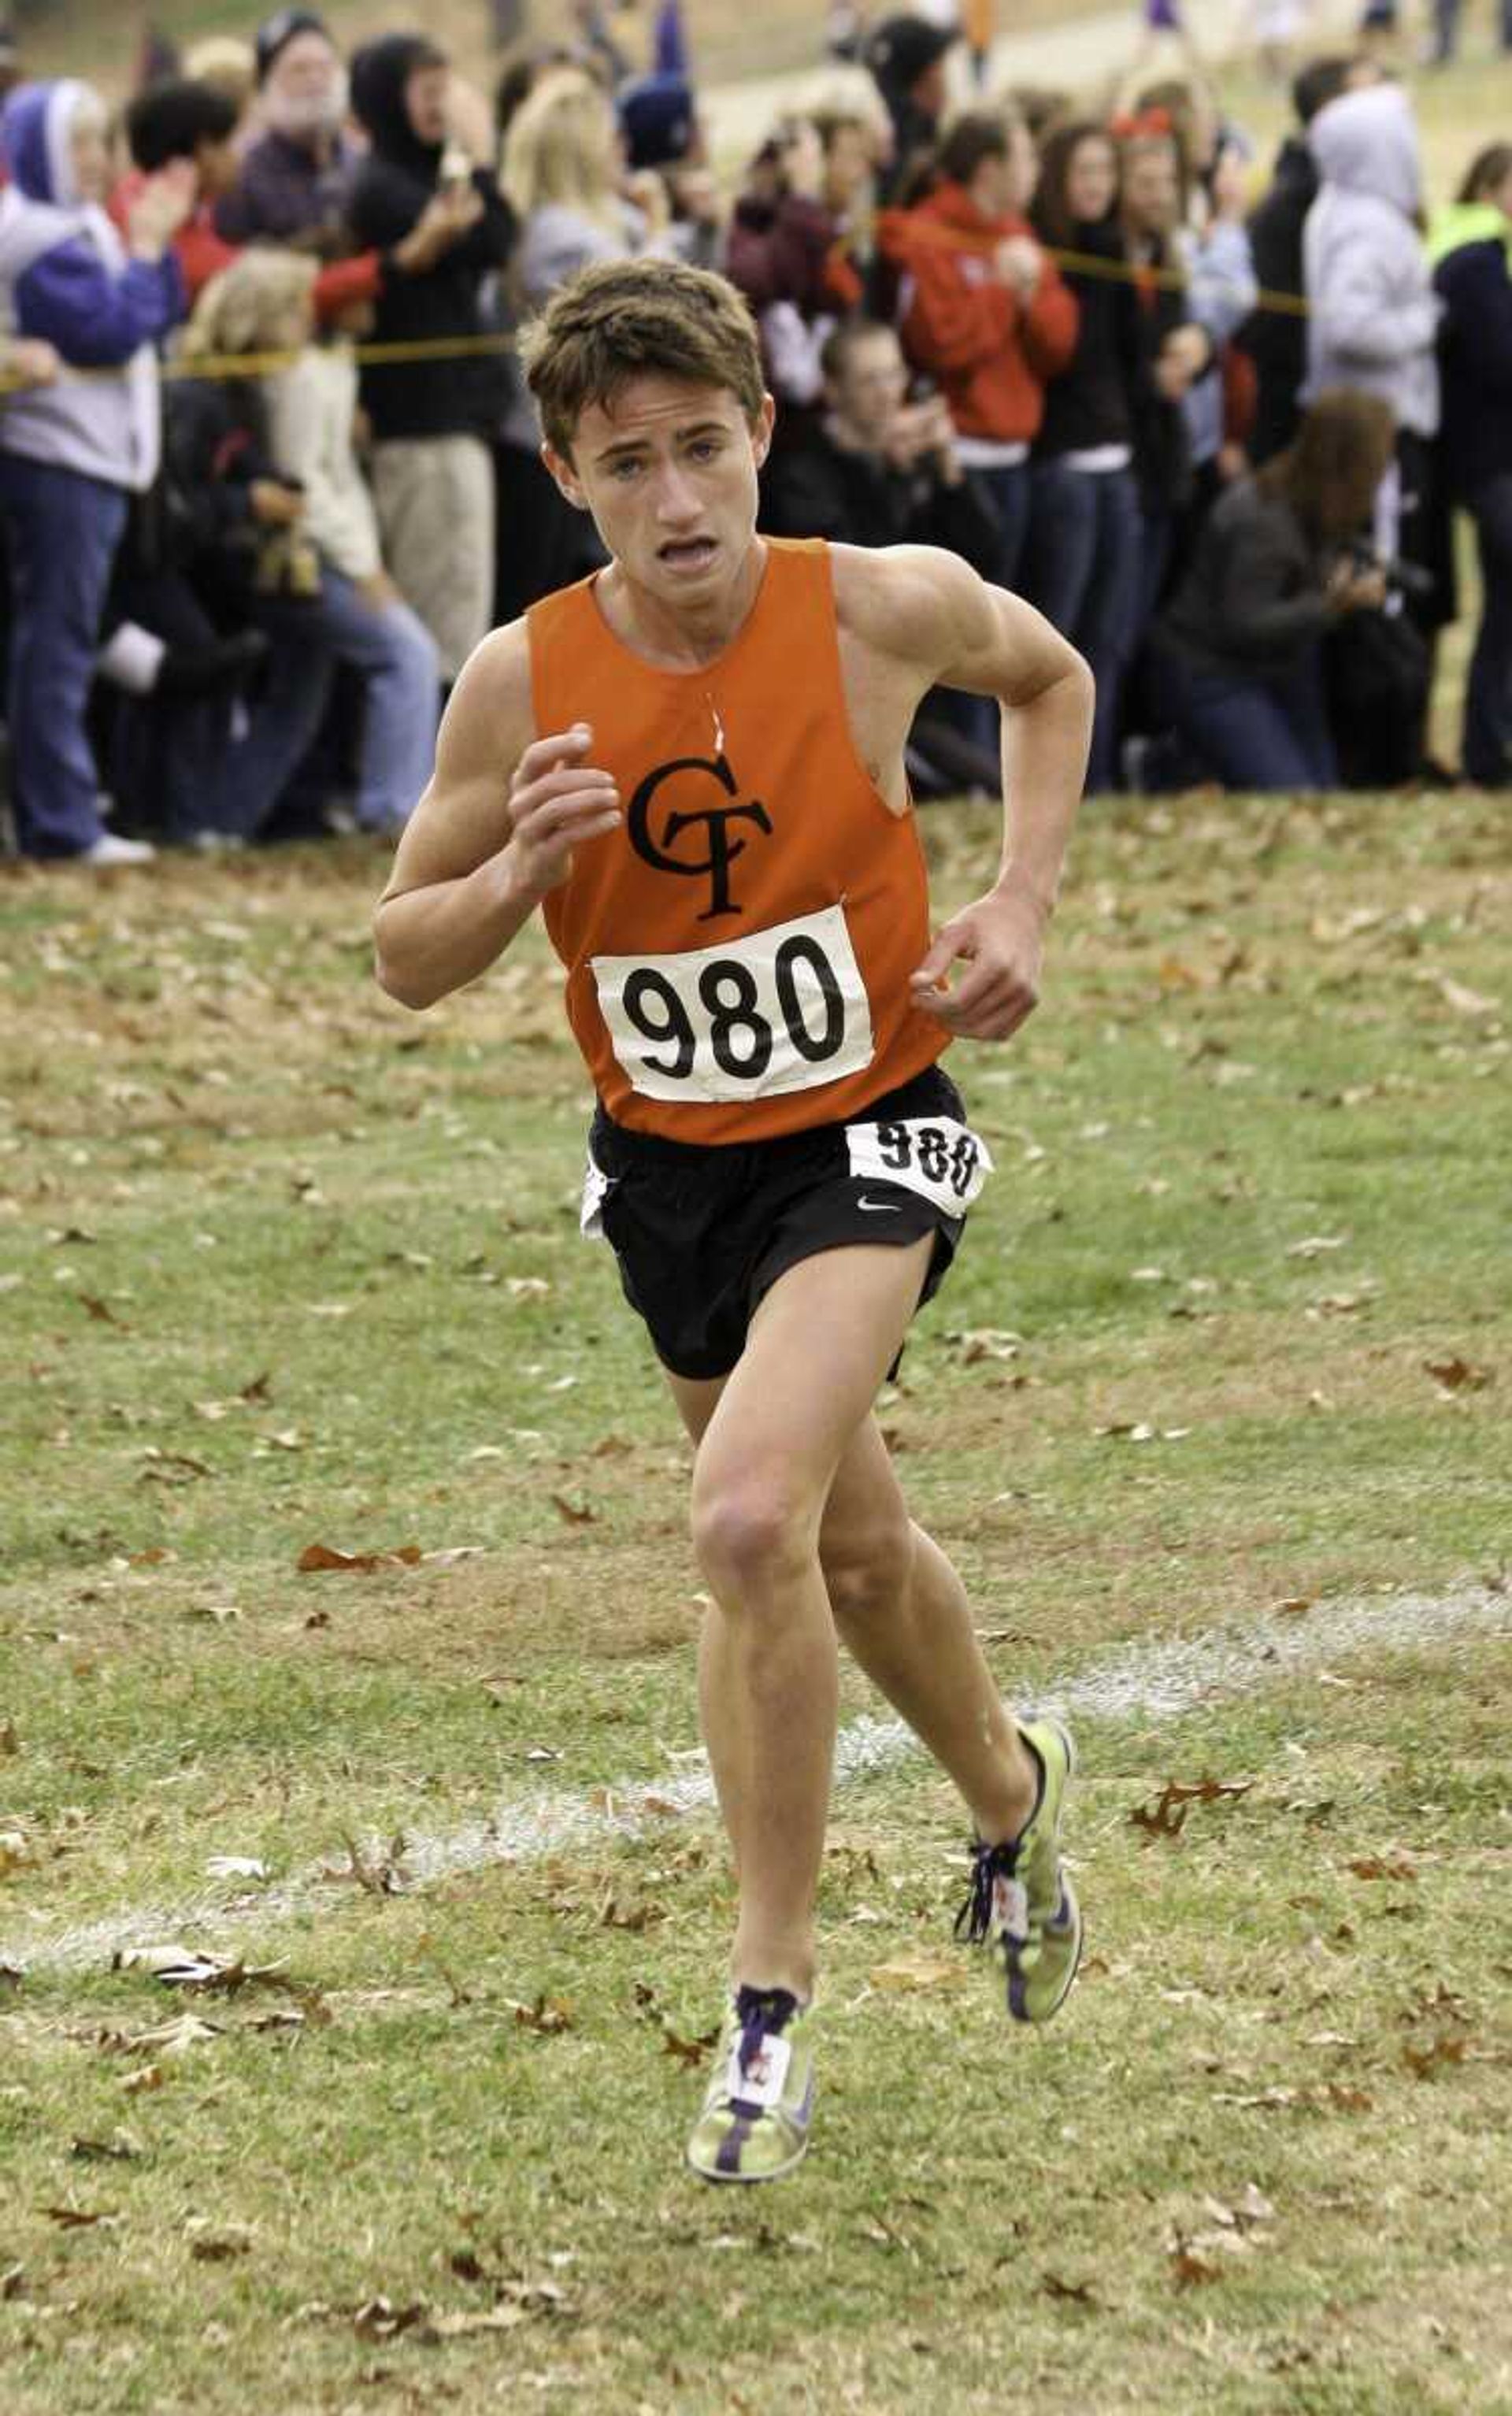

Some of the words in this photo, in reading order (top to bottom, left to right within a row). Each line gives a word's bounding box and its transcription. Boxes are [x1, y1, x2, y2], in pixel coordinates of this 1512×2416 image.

[628, 754, 773, 921] CT
[622, 935, 845, 1080] 980
[876, 1122, 978, 1197] 980
